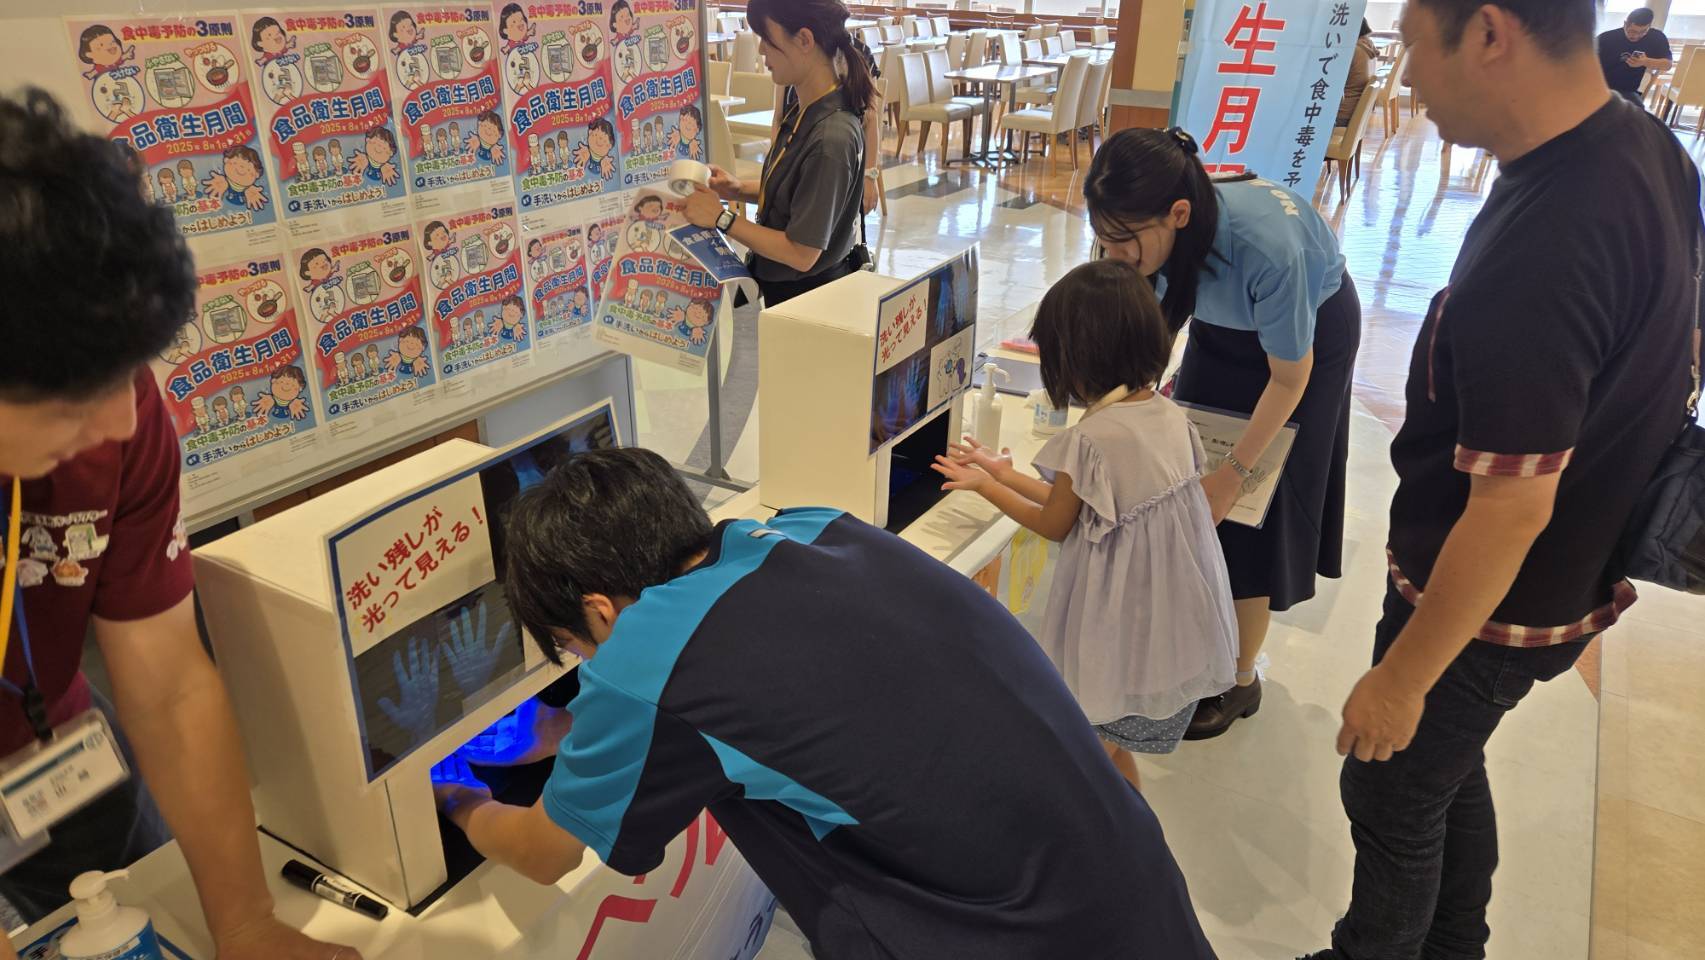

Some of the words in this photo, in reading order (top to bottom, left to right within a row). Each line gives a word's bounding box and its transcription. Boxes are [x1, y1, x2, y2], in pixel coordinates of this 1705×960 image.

[121, 20, 233, 41] 食中毒予防の3原則
[273, 88, 385, 143] 食品衛生月間
[405, 77, 495, 124] 食品衛生月間
[513, 78, 606, 135] 食品衛生月間
[620, 68, 696, 119] 食品衛生月間
[1283, 2, 1350, 187] 洗いで食中毒を予
[288, 173, 362, 196] 食中毒予防の基本
[437, 264, 518, 320] 食品衛生月間
[620, 258, 719, 289] 食品衛生月間
[319, 293, 417, 355] 食品衛生月間
[880, 293, 916, 346] 洗い残しが
[881, 298, 927, 364] 光って見える!
[169, 329, 292, 400] 食品衛生月間
[186, 415, 268, 451] 食中毒予防の基本
[346, 506, 443, 610] 洗い残しが
[361, 507, 484, 633] 光って見える!
